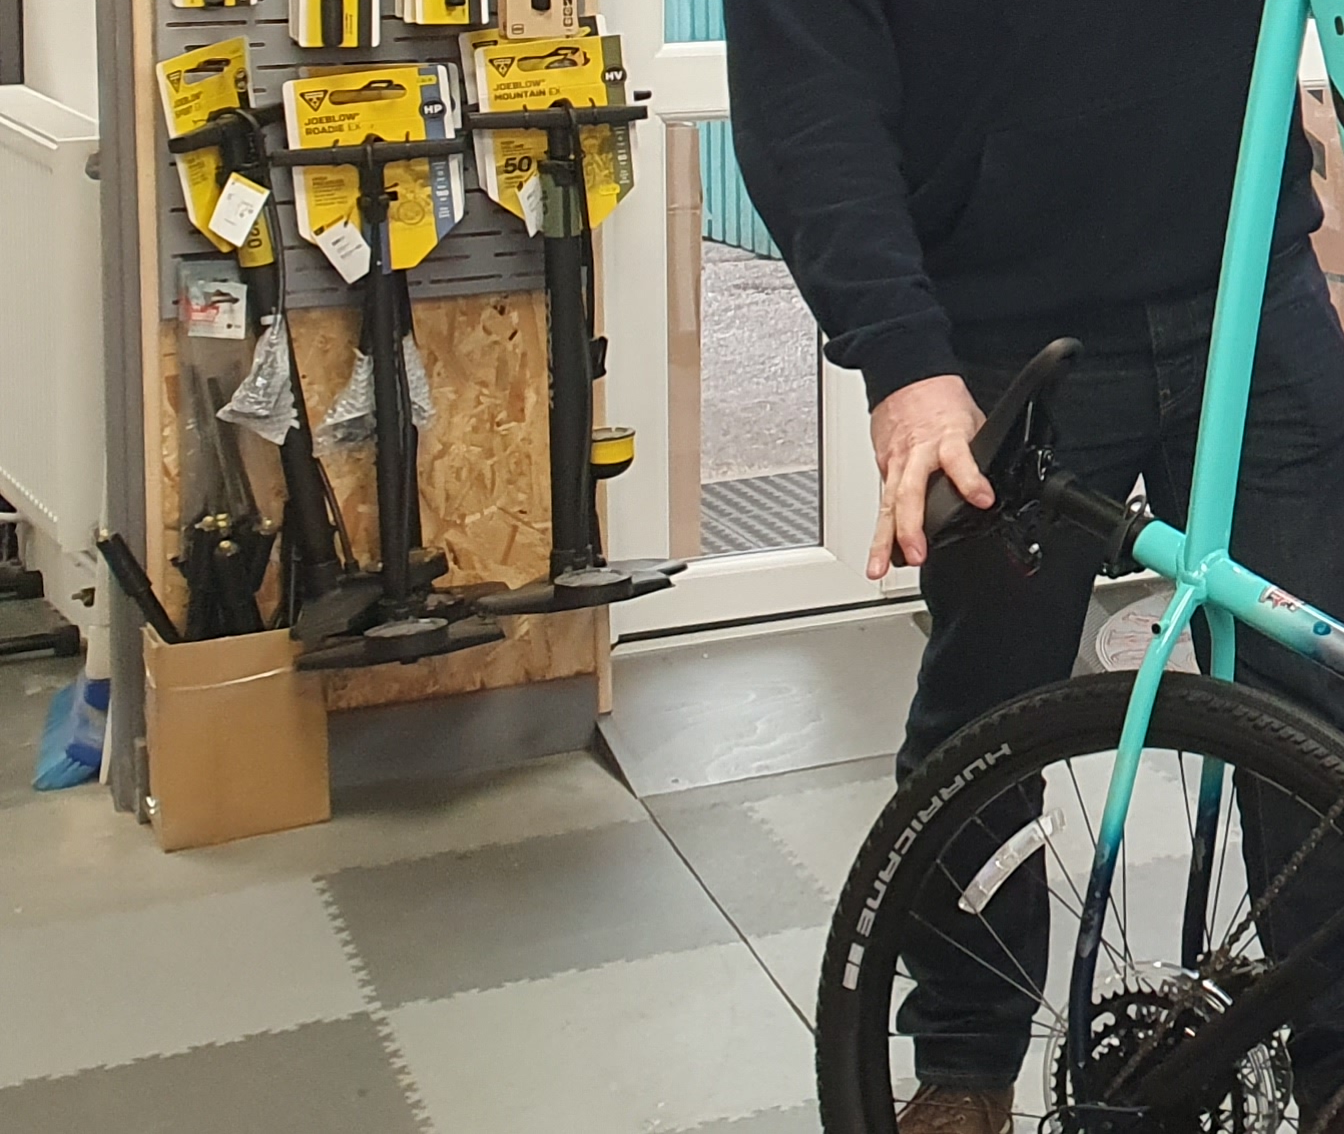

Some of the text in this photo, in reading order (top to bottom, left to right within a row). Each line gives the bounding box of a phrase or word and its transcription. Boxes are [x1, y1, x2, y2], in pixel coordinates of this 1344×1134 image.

[605, 71, 623, 80] HV
[493, 79, 545, 92] JOEBLOW
[494, 89, 546, 102] MOUNTAIN
[424, 105, 443, 114] HP
[304, 113, 357, 126] JOEBLOW
[305, 124, 344, 135] ROADIE
[504, 156, 532, 173] 50
[855, 743, 1011, 949] HURRICANE
